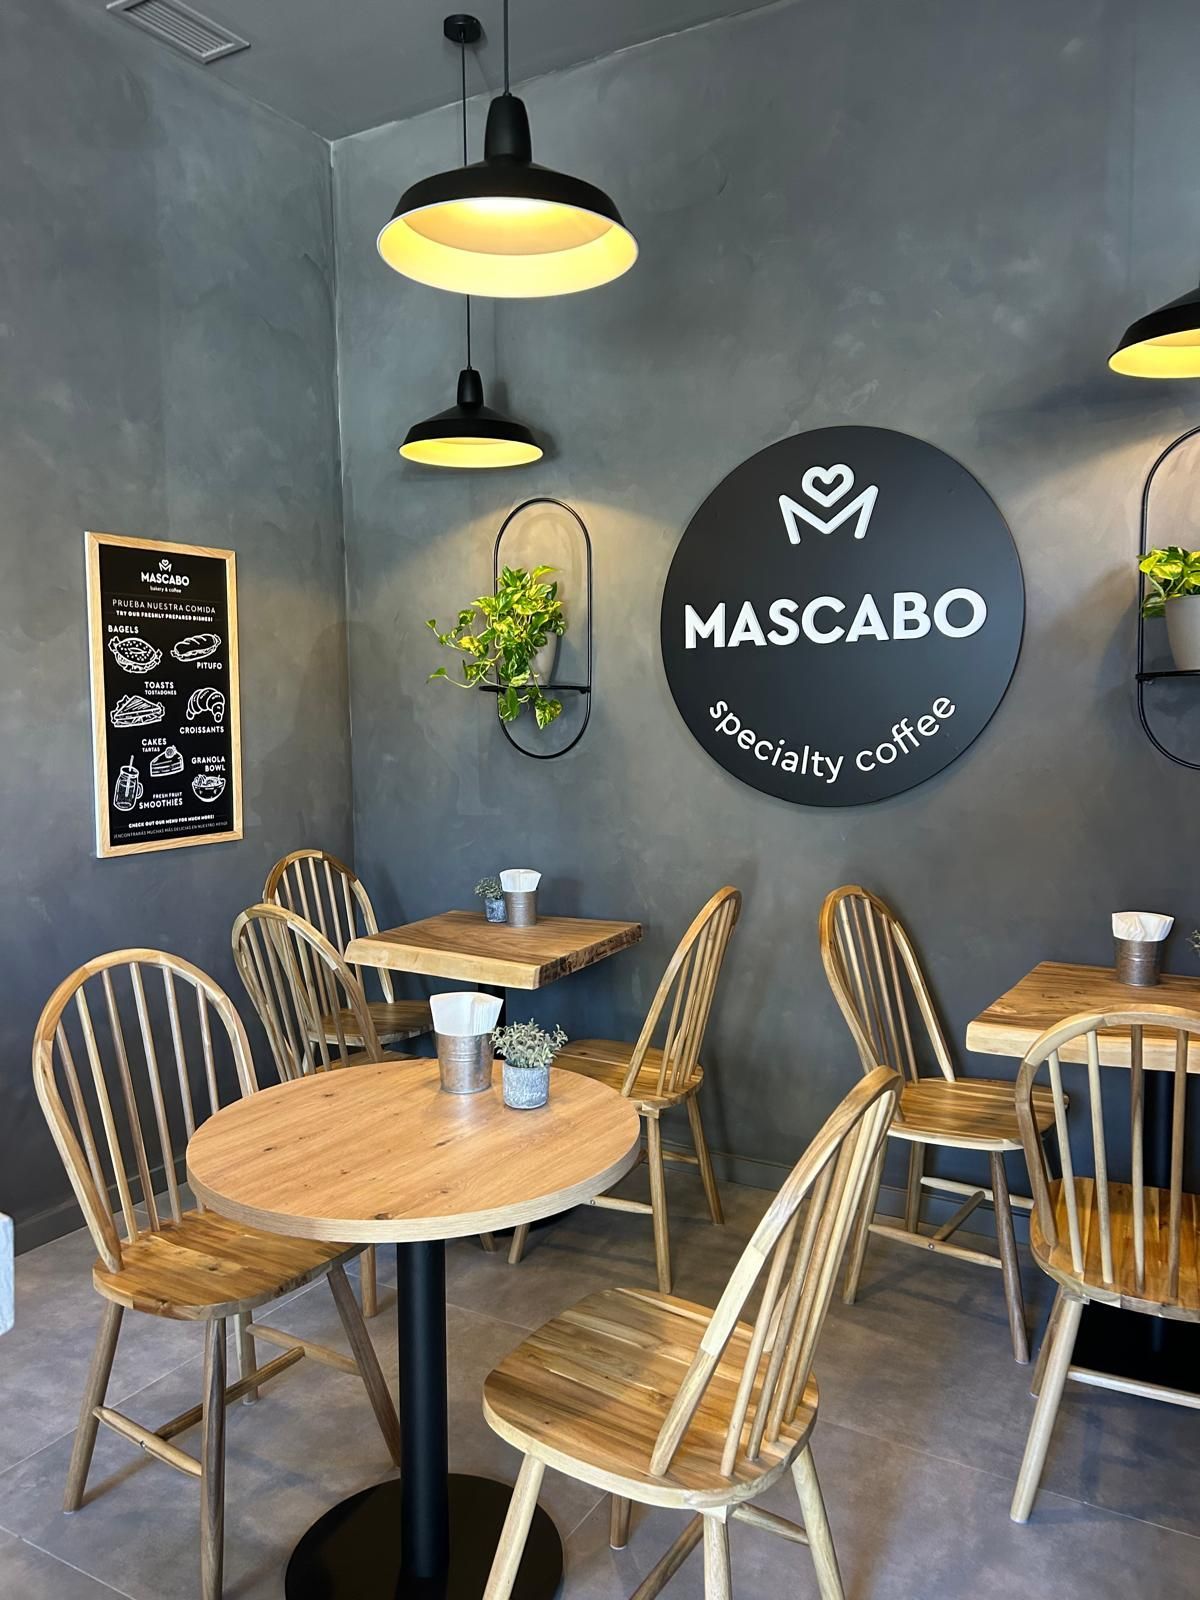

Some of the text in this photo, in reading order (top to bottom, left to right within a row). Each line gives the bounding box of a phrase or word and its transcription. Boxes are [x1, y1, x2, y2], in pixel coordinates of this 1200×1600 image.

[141, 571, 190, 587] MASCABO
[112, 599, 216, 614] PRUEBA NUESTRA COMIDA
[165, 613, 192, 621] PREPARED
[684, 587, 988, 650] MASCABO
[108, 625, 139, 634] BAGELS
[196, 662, 223, 670] PITUFO
[144, 681, 174, 689] TOASTS
[179, 726, 225, 735] CROISSANTS
[141, 738, 167, 746] CAKES
[709, 696, 956, 783] specialty coffee
[191, 756, 226, 765] GRANOLA
[204, 765, 226, 773] BOWL
[138, 797, 183, 810] SMOOTHIES
